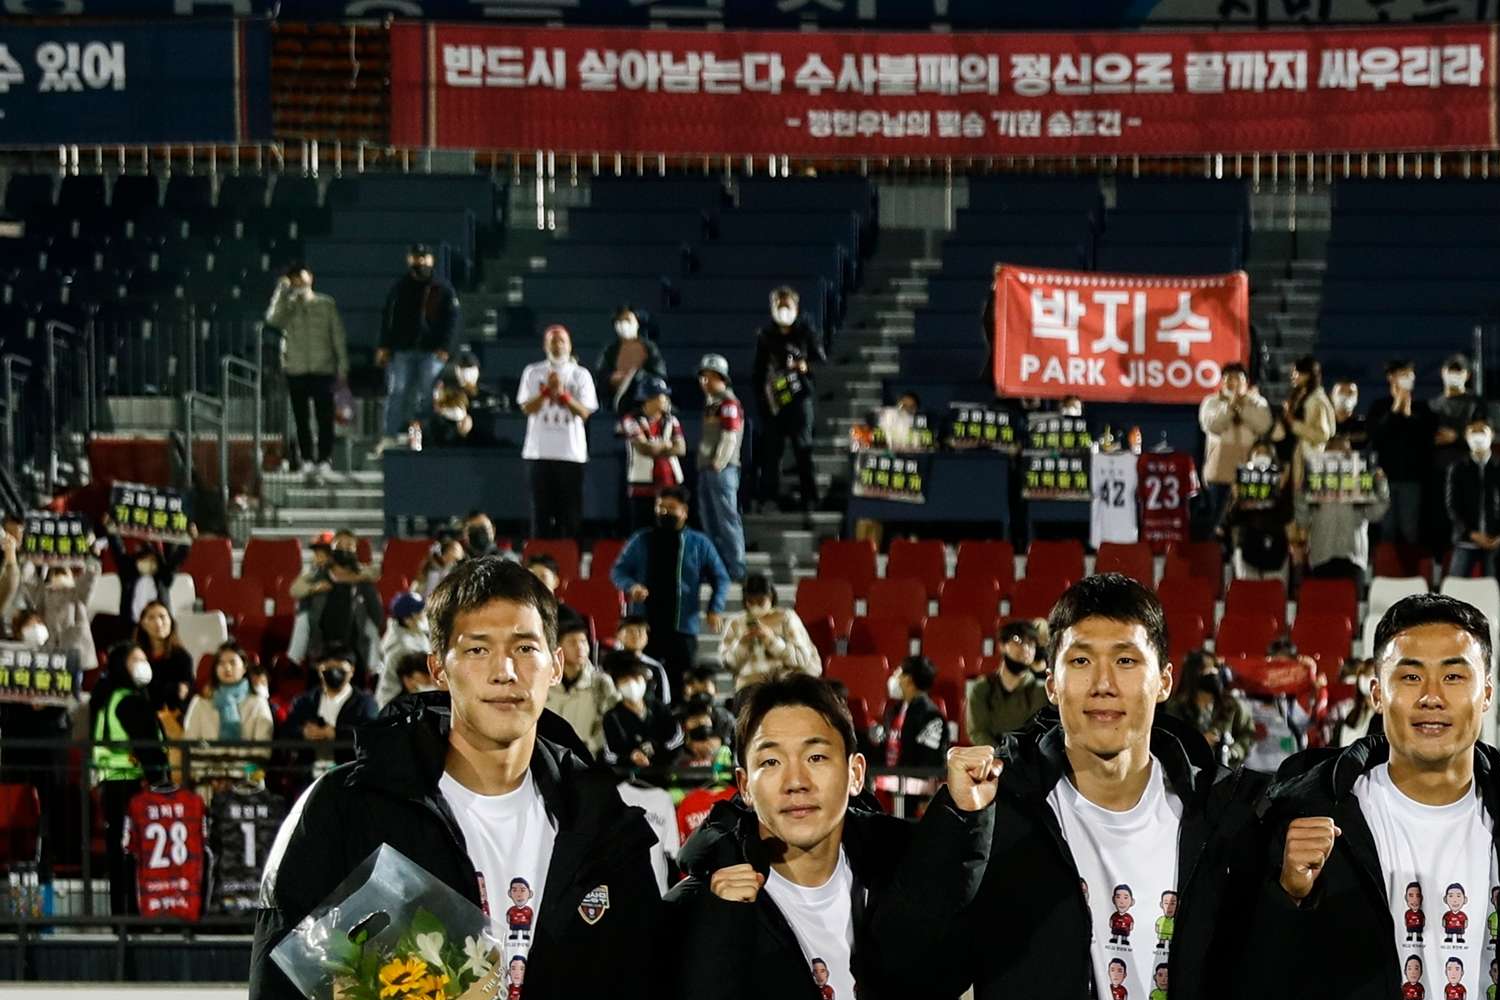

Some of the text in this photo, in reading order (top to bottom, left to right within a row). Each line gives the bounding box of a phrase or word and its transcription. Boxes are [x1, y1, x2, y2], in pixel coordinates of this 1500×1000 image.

[36, 41, 127, 92] 있어
[444, 44, 1484, 96] 반드시 살아남는다 수사불패의 정신으로 끝까지 싸우리라
[1030, 288, 1212, 356] 박지수
[1020, 353, 1222, 389] PARK JISOO
[1145, 474, 1180, 511] 23
[145, 821, 189, 869] 28
[240, 821, 256, 868] 1
